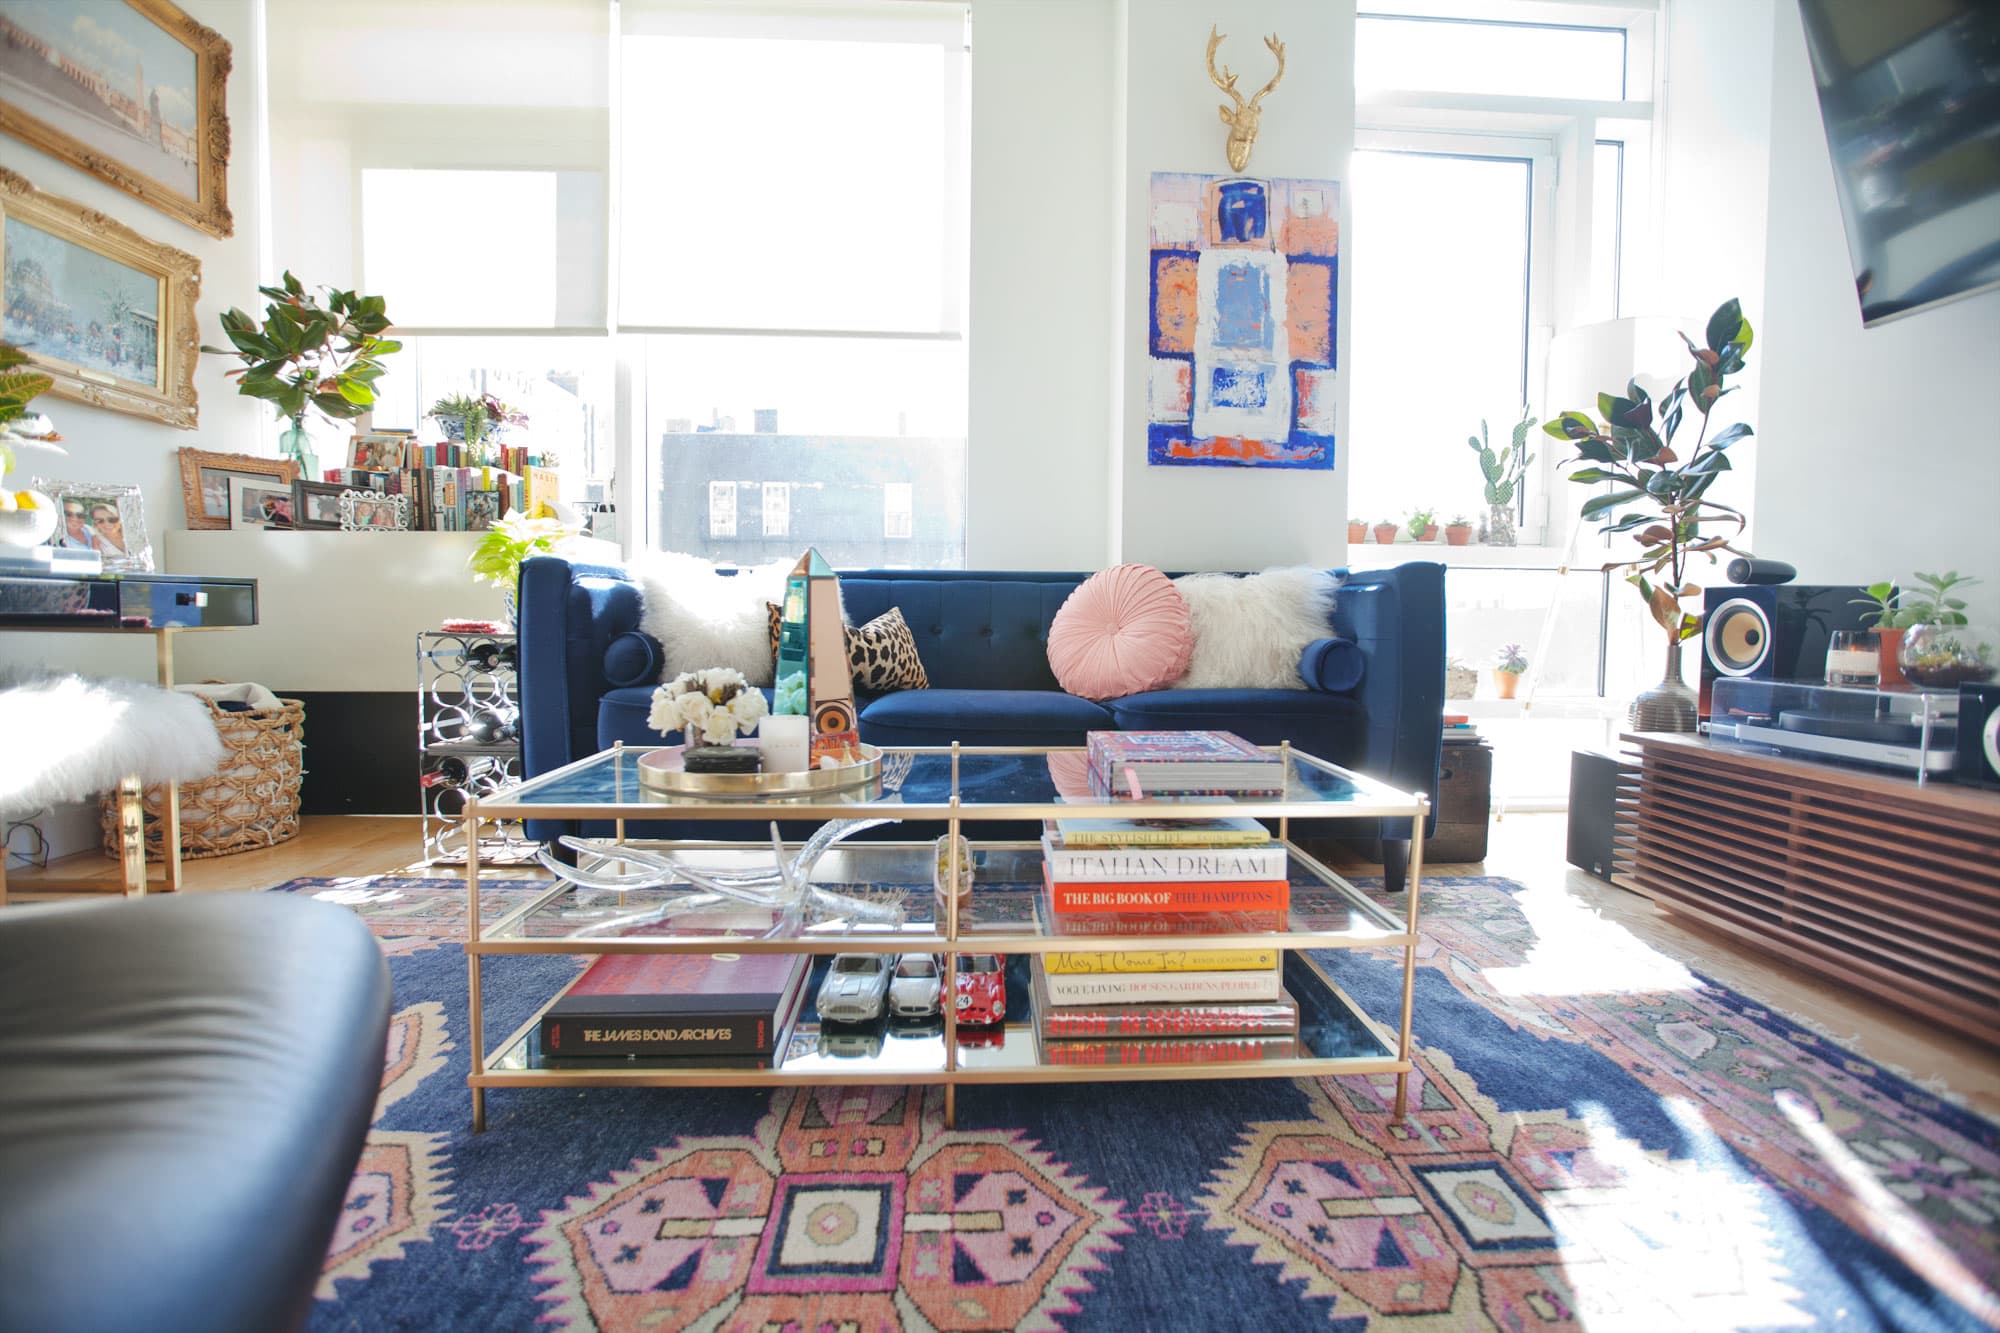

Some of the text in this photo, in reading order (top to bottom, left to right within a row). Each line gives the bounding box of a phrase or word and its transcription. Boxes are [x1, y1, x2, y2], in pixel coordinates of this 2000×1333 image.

[1072, 833, 1096, 843] THE
[1101, 832, 1152, 843] STYLISH
[1067, 856, 1267, 876] ITALIAN DREAM
[1063, 889, 1273, 905] THE BIG BOOK OF THE HAMPTONS
[1054, 951, 1092, 973] May
[1095, 952, 1108, 972] I
[1112, 951, 1154, 971] Come
[1056, 984, 1090, 995] VOGUE
[1091, 983, 1126, 994] LIVING
[583, 1028, 733, 1042] THE JAMES BOND ARCHIVES
